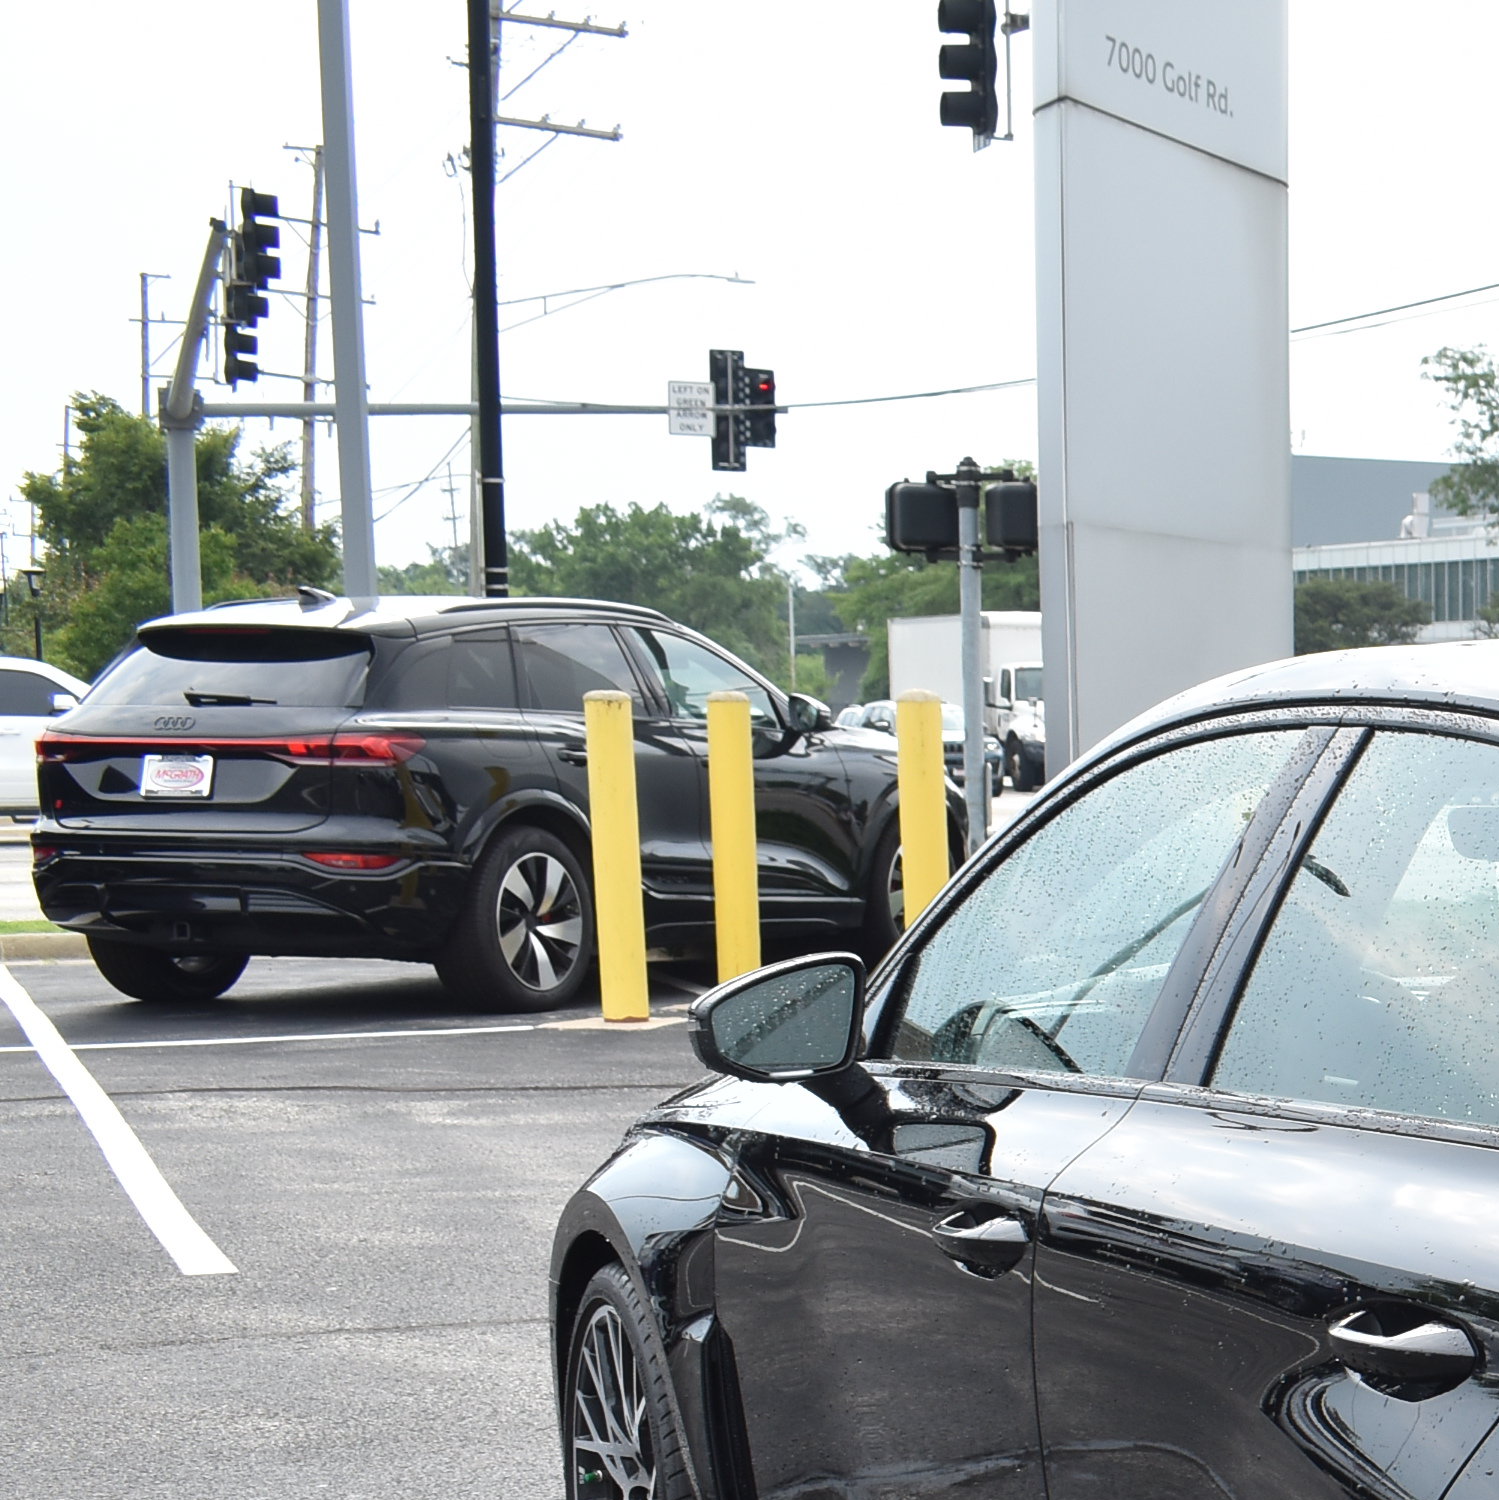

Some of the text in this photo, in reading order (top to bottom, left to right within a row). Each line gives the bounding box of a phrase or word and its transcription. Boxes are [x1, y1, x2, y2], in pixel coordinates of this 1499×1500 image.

[1104, 34, 1233, 118] 7000 Golf Rd.
[672, 384, 710, 395] LEFT ON
[679, 423, 704, 432] ONLY
